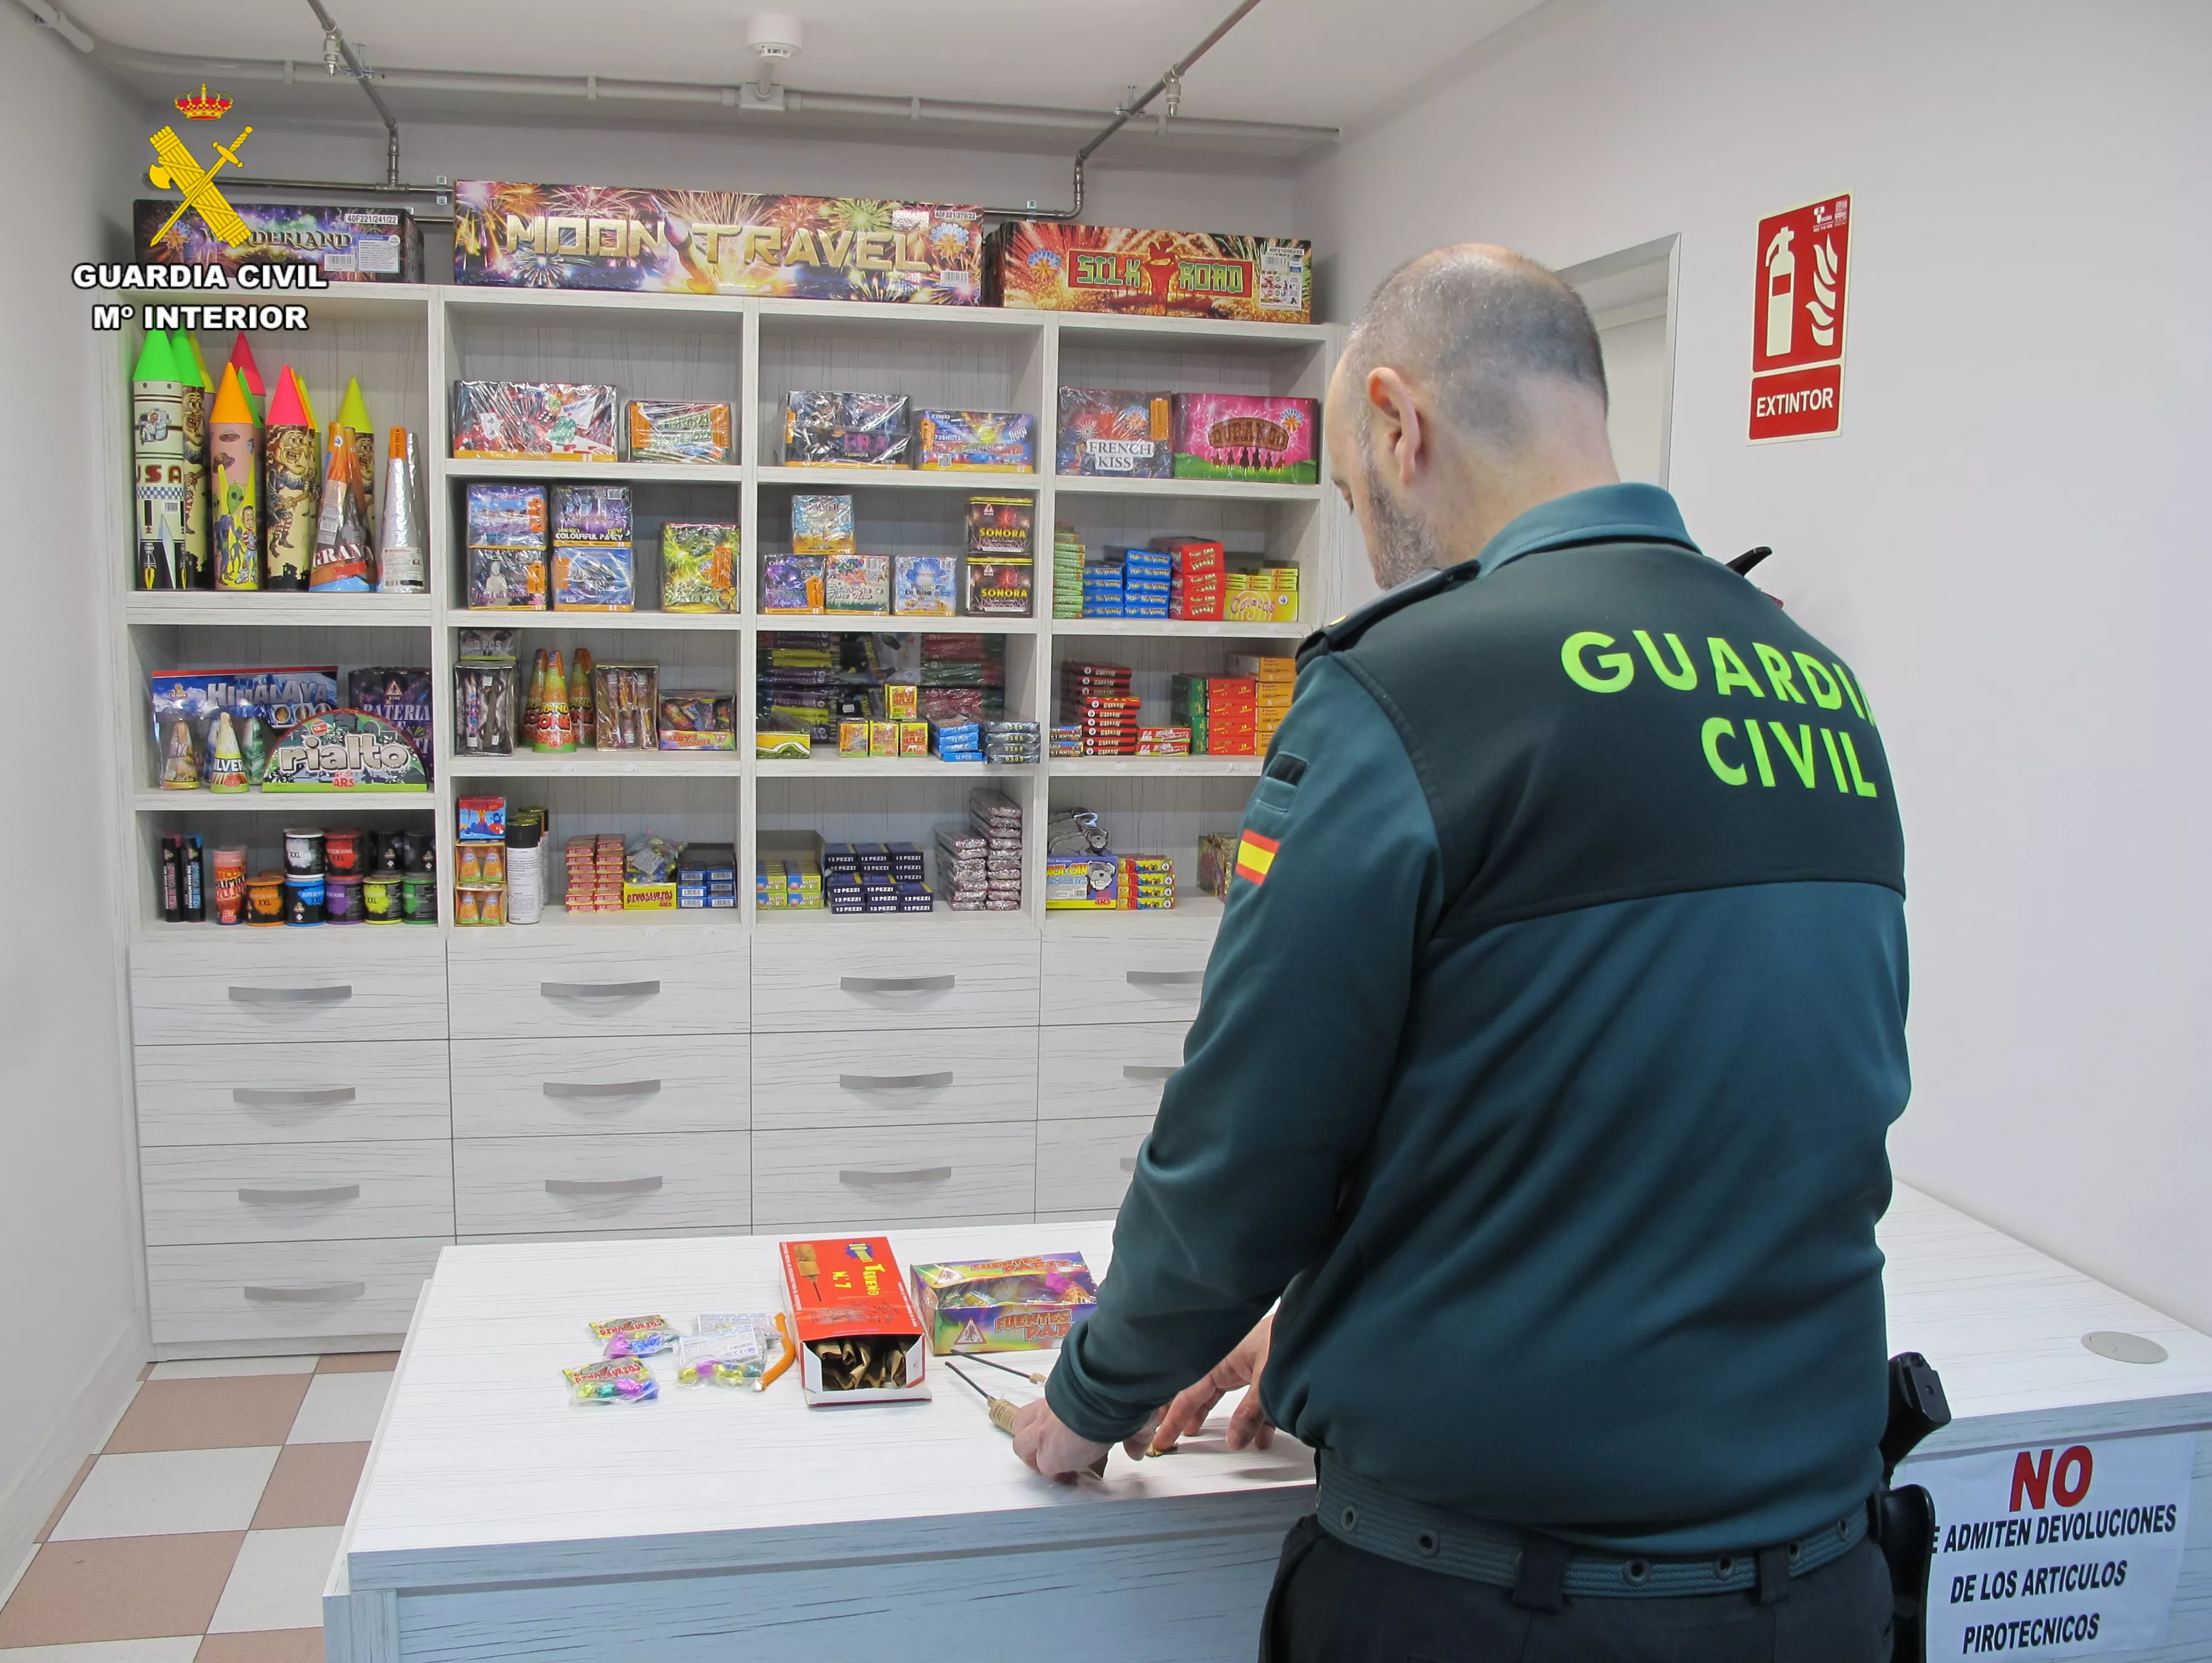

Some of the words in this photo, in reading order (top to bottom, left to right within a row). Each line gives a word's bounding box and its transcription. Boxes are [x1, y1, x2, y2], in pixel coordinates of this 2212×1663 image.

[200, 227, 352, 250] WDERLAND
[506, 214, 669, 258] MOON
[692, 223, 933, 273] TRAVEL
[1076, 254, 1142, 288] SILK
[1178, 260, 1244, 294] ROAD
[1756, 387, 1834, 418] EXTINTOR
[1089, 441, 1152, 456] FRENCH
[1099, 456, 1132, 469] KISS
[979, 528, 1027, 538] SONORA
[981, 589, 1029, 599] SONORA
[482, 640, 501, 650] PCS
[208, 680, 329, 707] HIMALAYA
[542, 703, 569, 714] RAND
[539, 714, 571, 730] ONE
[281, 735, 409, 771] rialto
[1701, 717, 1877, 798] CIVIL
[214, 758, 245, 772] ILVER
[332, 777, 356, 788] ARS
[627, 890, 673, 904] DINOSAURIOS
[971, 1257, 1044, 1271] FUENTES
[1002, 1260, 1072, 1273] PARTY
[863, 1263, 887, 1296] TRUENO
[994, 1310, 1072, 1332] FUENTES
[1024, 1324, 1073, 1341] PAR
[574, 1363, 642, 1384] DINOAURIOS
[2009, 1445, 2093, 1513] NO
[1943, 1518, 2032, 1553] ADMITEN
[2035, 1504, 2177, 1544] DEVOLUCIONES
[1950, 1575, 1977, 1604] DE
[1980, 1570, 2018, 1601] LOS
[2020, 1560, 2128, 1597] ARTICULOS
[1962, 1612, 2101, 1655] PIROTECNICOS
